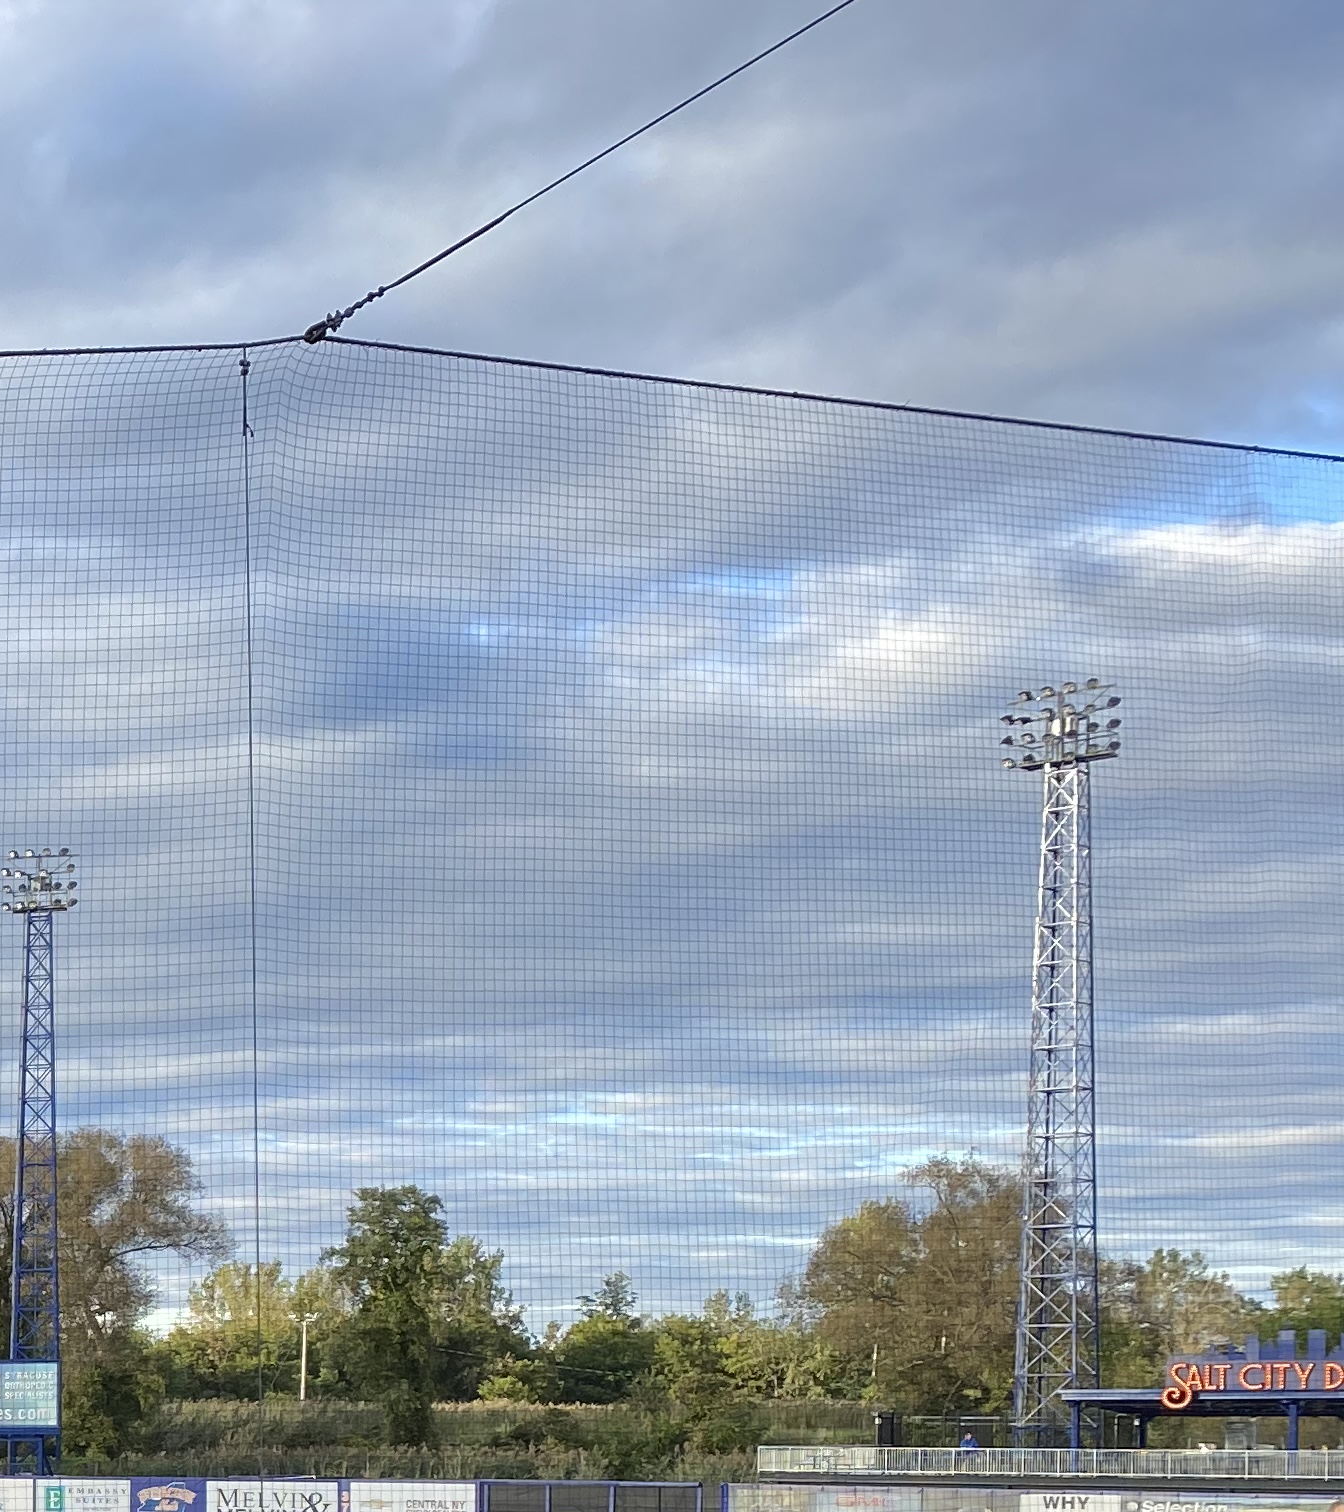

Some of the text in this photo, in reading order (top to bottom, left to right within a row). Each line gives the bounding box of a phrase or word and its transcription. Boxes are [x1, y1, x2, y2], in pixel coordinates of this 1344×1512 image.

[4, 1381, 54, 1390] ORTHOPEDC
[1161, 1361, 1232, 1410] SALT
[1238, 1361, 1316, 1390] CITY
[217, 1488, 310, 1508] MELVIN
[405, 1500, 466, 1510] CENTRAL NY
[1043, 1496, 1089, 1510] WHY
